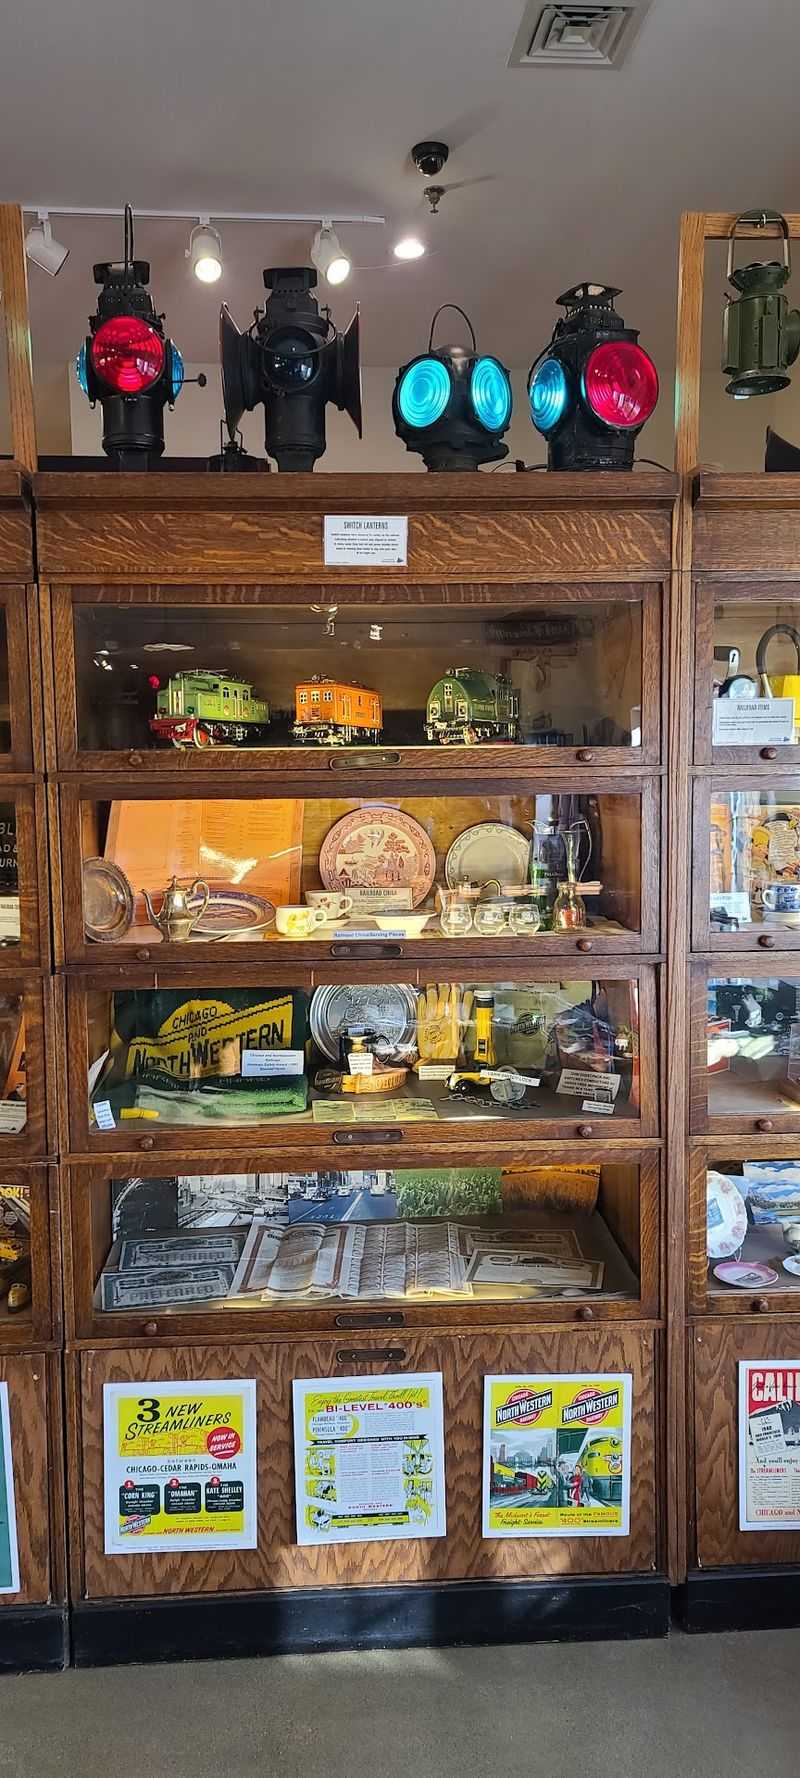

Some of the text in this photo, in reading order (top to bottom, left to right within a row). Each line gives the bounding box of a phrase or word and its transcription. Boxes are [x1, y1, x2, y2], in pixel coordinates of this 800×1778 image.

[344, 521, 388, 529] SWITCH LANTERNS
[172, 1006, 218, 1029] CHICAGO
[129, 1284, 214, 1301] PREFERRED
[137, 1398, 203, 1422] 3 NEW
[326, 1403, 384, 1413] BI-LEVEL
[497, 1394, 551, 1422] NORTH WESTERN
[563, 1394, 617, 1422] NORTH WESTERN
[125, 1412, 232, 1441] STREAMLINERS
[212, 1433, 227, 1442] NOW
[210, 1441, 236, 1452] SERVICE
[126, 1462, 237, 1474] CHICAGO-CEDAR RAPIDS-OMAHA
[755, 1509, 783, 1517] CHICAGO
[500, 1519, 521, 1528] Freight
